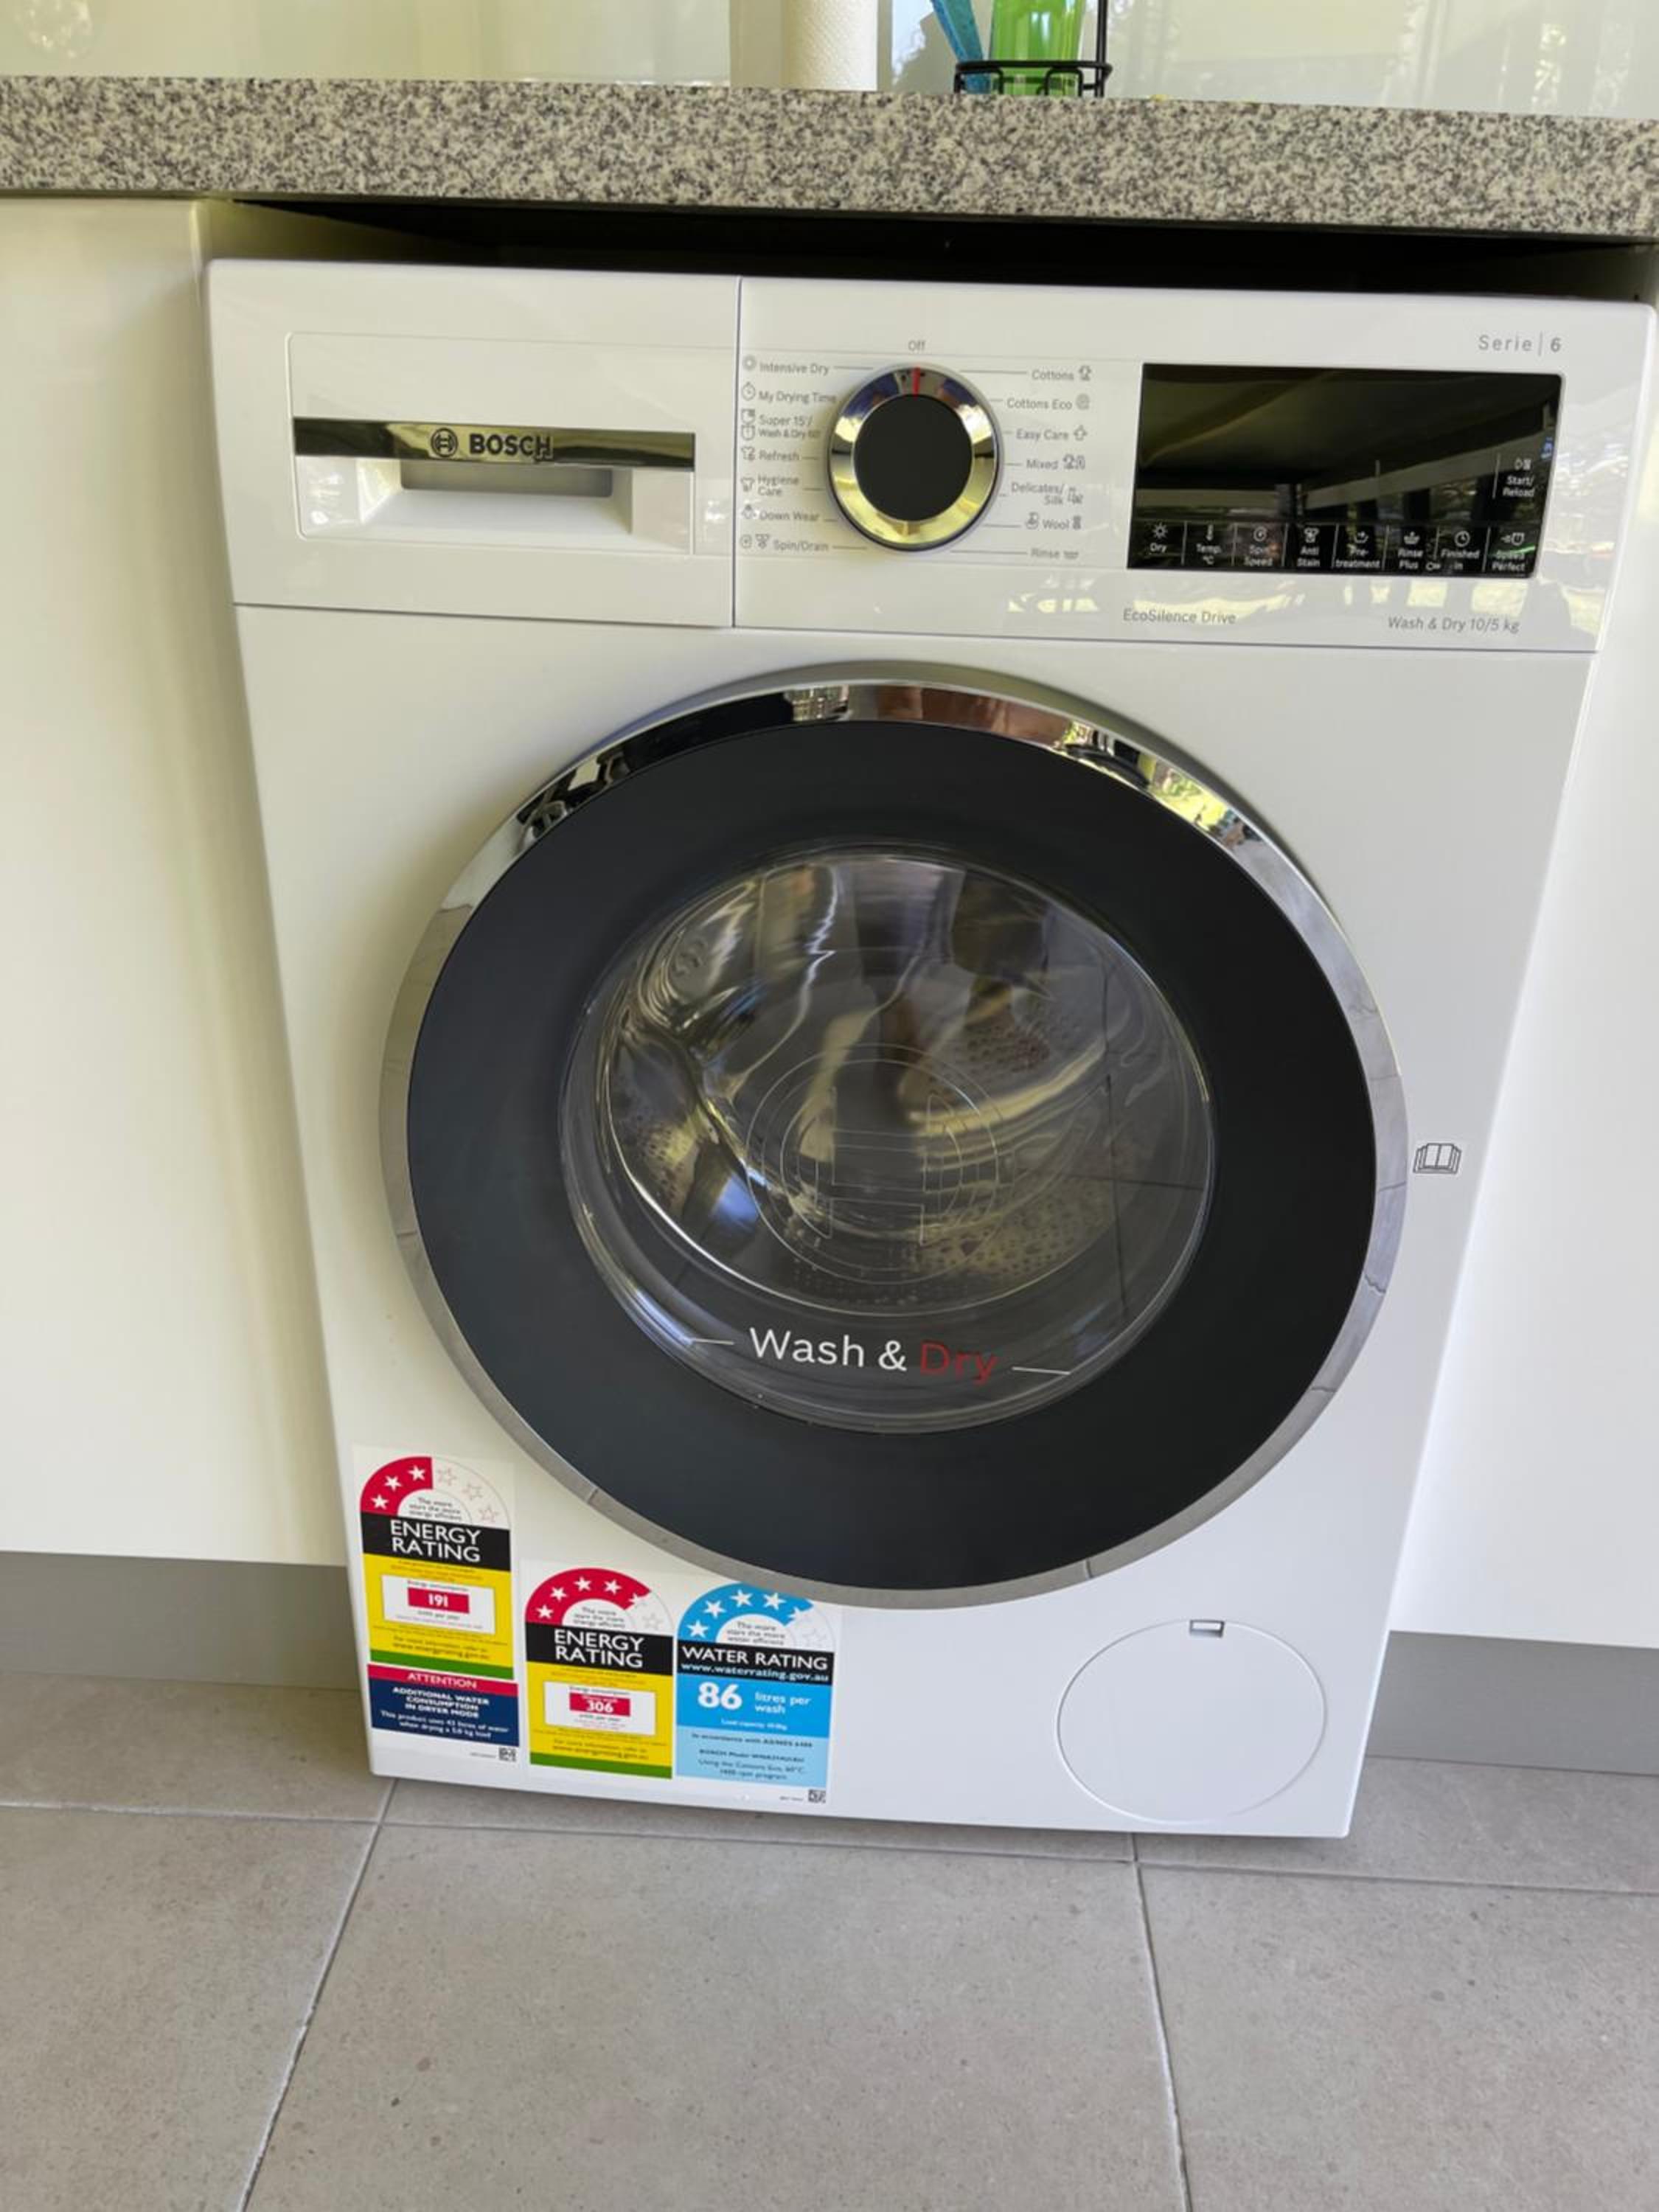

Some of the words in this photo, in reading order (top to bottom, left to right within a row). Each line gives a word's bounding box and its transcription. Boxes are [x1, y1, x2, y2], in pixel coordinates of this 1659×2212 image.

[908, 340, 927, 352] Off
[1478, 334, 1532, 352] Serie
[1550, 337, 1562, 352] 6
[759, 362, 807, 374] Intensive
[811, 364, 830, 376] Dry
[1032, 369, 1074, 380] Cottons
[759, 391, 773, 403] My
[776, 391, 810, 404] Drying
[813, 392, 837, 402] Time
[1006, 397, 1048, 409] Cottons
[1052, 399, 1073, 410] Eco
[759, 414, 791, 427] Super
[783, 429, 790, 438] &
[1017, 428, 1040, 444] Easy
[1043, 429, 1068, 440] Care
[469, 434, 552, 458] BOSCH
[759, 450, 800, 461] Refresh
[1026, 459, 1059, 470] Mixed
[758, 486, 782, 496] Care
[1503, 487, 1535, 498] Reload
[759, 511, 790, 521] Down
[1043, 519, 1070, 530] Wool
[773, 540, 829, 552] Spin/Drain
[1150, 543, 1166, 553] Dry
[1301, 546, 1320, 555] Anti
[1297, 557, 1321, 567] Stain
[1335, 560, 1380, 568] treatment
[1399, 560, 1419, 569] Plus
[1492, 561, 1526, 571] Perfect
[1123, 609, 1196, 624] EcoSilence
[1201, 611, 1237, 625] Drive
[1388, 616, 1424, 630] Wash
[1427, 618, 1439, 630] &
[1441, 619, 1466, 634] Dry
[1471, 618, 1500, 632] 10/5
[1503, 619, 1520, 635] kg
[748, 1327, 864, 1367] Wash
[877, 1340, 908, 1371] &
[919, 1338, 998, 1385] Dry
[390, 1520, 481, 1545] ENERGY
[392, 1536, 481, 1562] RATING
[428, 1593, 449, 1607] 191
[554, 1628, 644, 1652] ENERGY
[555, 1645, 643, 1669] RATING
[681, 1645, 748, 1664] WATER
[754, 1652, 828, 1671] RATING
[681, 1662, 830, 1683] www.waterrating.gov.au
[407, 1672, 477, 1688] ATTENTION
[392, 1686, 452, 1701] ADDITIONAL
[456, 1694, 490, 1705] WATER
[698, 1681, 743, 1711] 86
[754, 1691, 786, 1704] litres
[790, 1696, 811, 1707] per
[405, 1703, 416, 1711] IN
[418, 1704, 448, 1715] DRYER
[451, 1708, 479, 1719] MODE
[406, 1697, 479, 1711] CONSUMPTION
[586, 1700, 614, 1714] 306
[754, 1703, 786, 1714] wash
